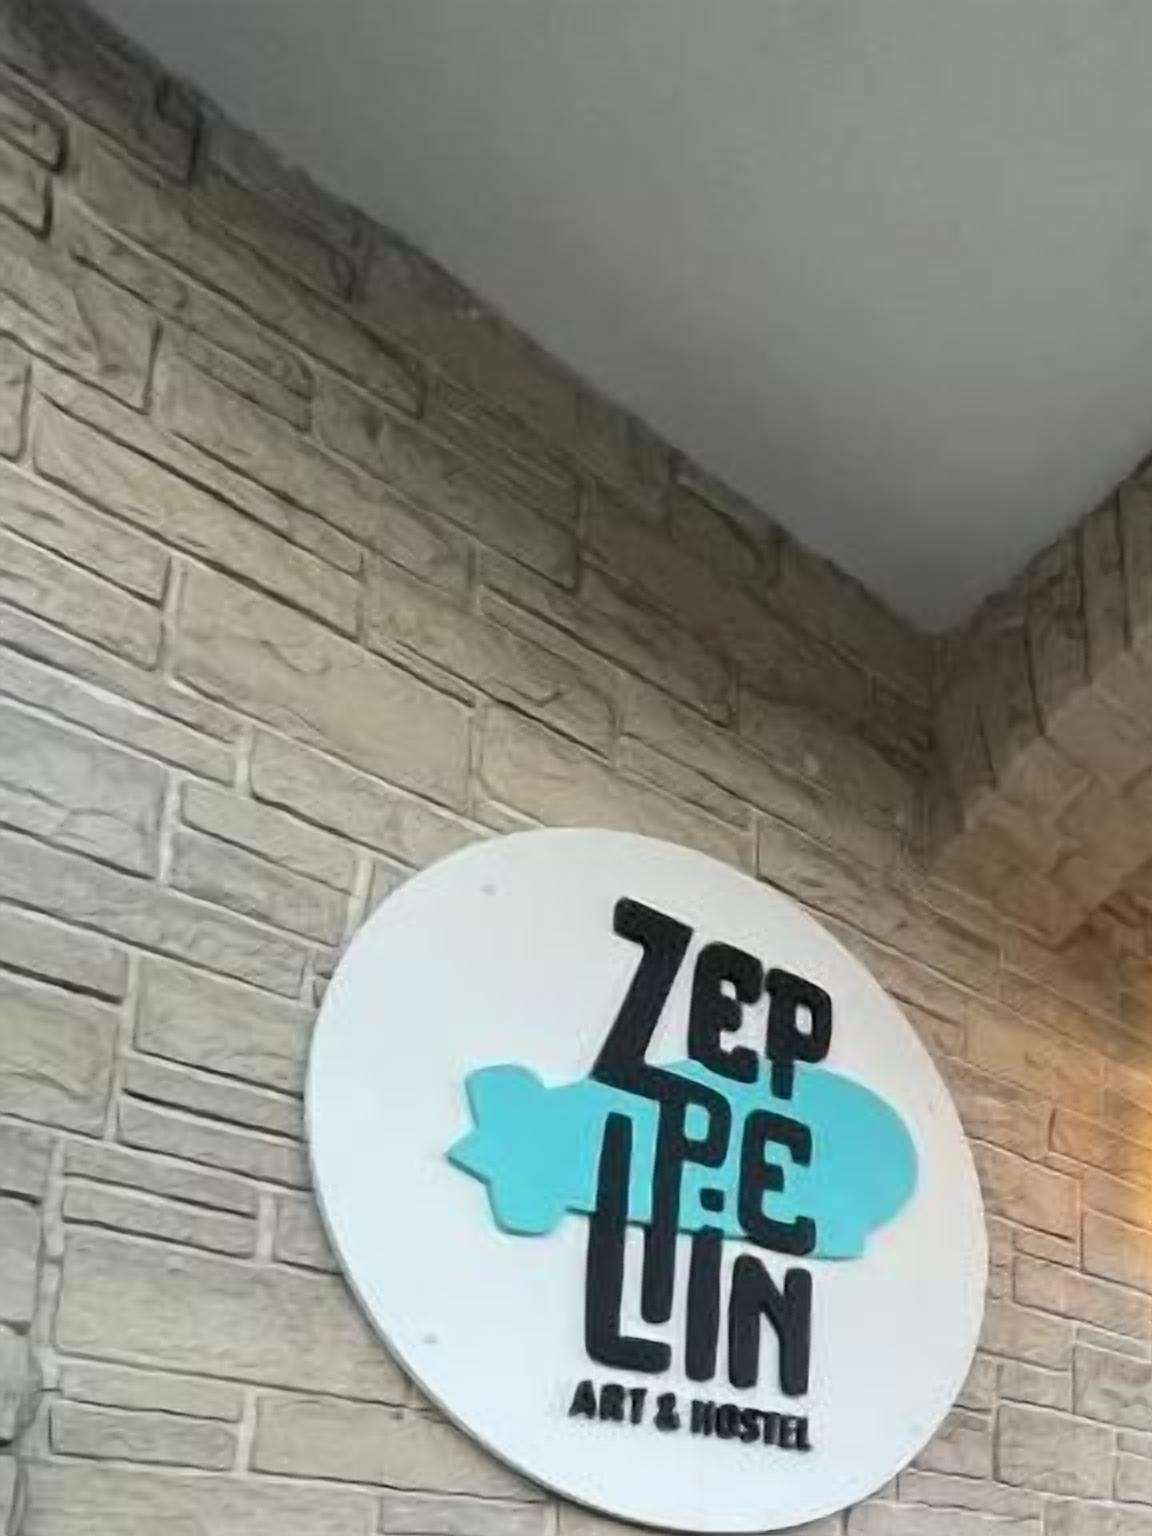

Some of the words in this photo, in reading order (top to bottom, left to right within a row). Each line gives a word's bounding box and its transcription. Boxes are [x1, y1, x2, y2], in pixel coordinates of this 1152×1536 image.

[590, 896, 833, 1101] ZEP
[568, 1380, 647, 1425] ART
[653, 1392, 680, 1431] &
[690, 1399, 811, 1451] HOSTEL
